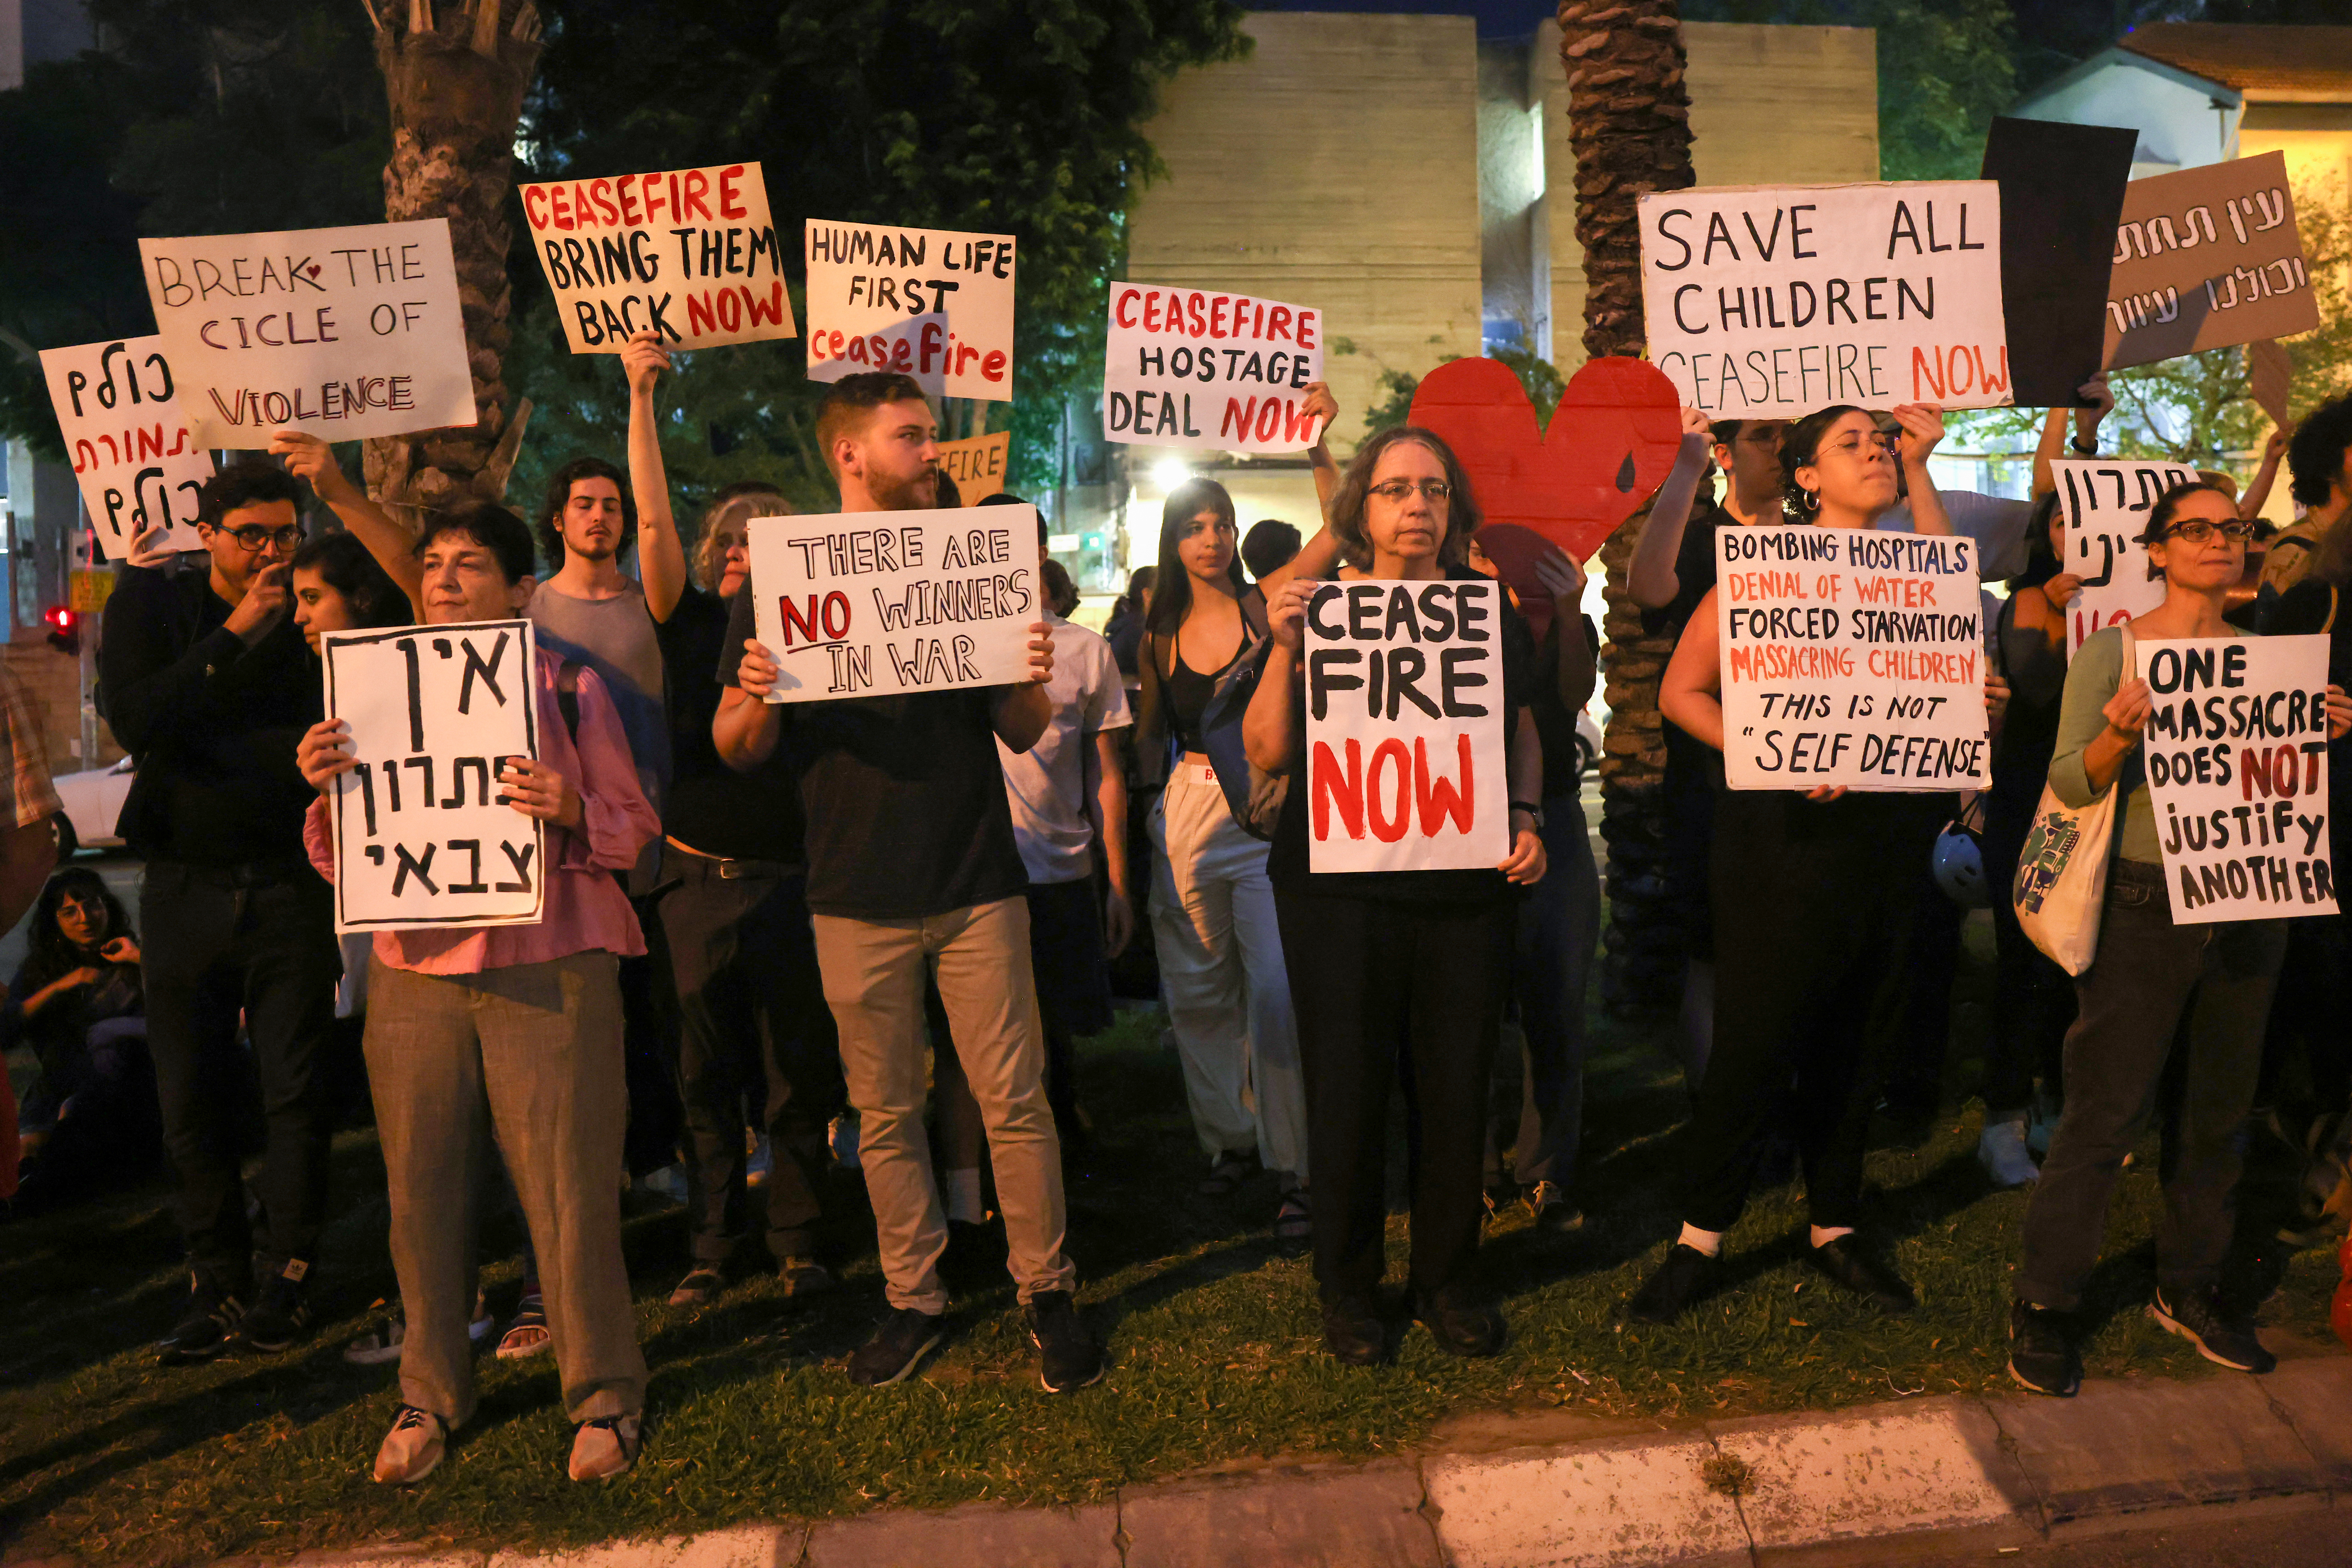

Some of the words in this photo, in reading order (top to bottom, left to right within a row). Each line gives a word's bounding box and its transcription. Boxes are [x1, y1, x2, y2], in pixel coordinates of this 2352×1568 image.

[525, 165, 746, 230] CEASEFIRE
[2226, 187, 2285, 244] עין
[545, 230, 659, 289] BRING
[670, 227, 779, 278] THEM
[813, 228, 925, 266] HUMAN
[944, 240, 1012, 279] LIFE
[1655, 205, 1817, 271] SAVE
[1888, 200, 1984, 260] ALL
[2112, 206, 2217, 264] תחת
[155, 256, 326, 306] BREAK
[331, 244, 424, 287] THE
[849, 276, 959, 314] FIRST
[2204, 257, 2306, 312] וכולנו
[201, 306, 338, 349] CICLE
[370, 302, 426, 335] OF
[576, 292, 682, 345] BACK
[687, 281, 782, 337] NOW
[1116, 289, 1315, 349] CEASEFIRE
[1674, 277, 1934, 334] CHILDREN
[1140, 347, 1310, 388] HOSTAGE
[1912, 345, 2008, 401] NOW
[208, 376, 415, 426] VIOLENCE
[1110, 391, 1201, 436] DEAL
[1221, 395, 1313, 443] NOW
[941, 446, 1001, 481] FIRE
[788, 527, 923, 579] THERE
[942, 529, 1009, 569] ARE
[1724, 533, 1839, 561] BOMBING
[1849, 535, 1969, 574] HOSPITALS
[779, 590, 851, 645] NO
[873, 569, 1032, 632] WINNERS
[1308, 584, 1490, 642] CEASE
[1729, 570, 1807, 602] DENIAL
[1817, 574, 1841, 603] OF
[1854, 576, 1936, 607] WATER
[1730, 607, 1839, 640] FORCED
[1851, 610, 1976, 643] STARVATION
[397, 631, 510, 752] אין
[827, 645, 872, 693] IN
[887, 635, 982, 686] WAR
[1310, 647, 1489, 721] FIRE
[1730, 644, 1855, 683] MASSACRING
[1868, 649, 1975, 684] CHILDREN
[2148, 645, 2247, 694] ONE
[1760, 693, 1831, 720] THIS
[1848, 694, 1874, 719] IS
[1886, 695, 1947, 719] NOT
[2148, 689, 2326, 741] MASSACRE
[1313, 733, 1474, 842] NOW
[2150, 743, 2232, 787] DOES
[2241, 741, 2327, 801] NOT
[365, 839, 535, 898] צבאי
[2180, 855, 2336, 909] ANOTHER
